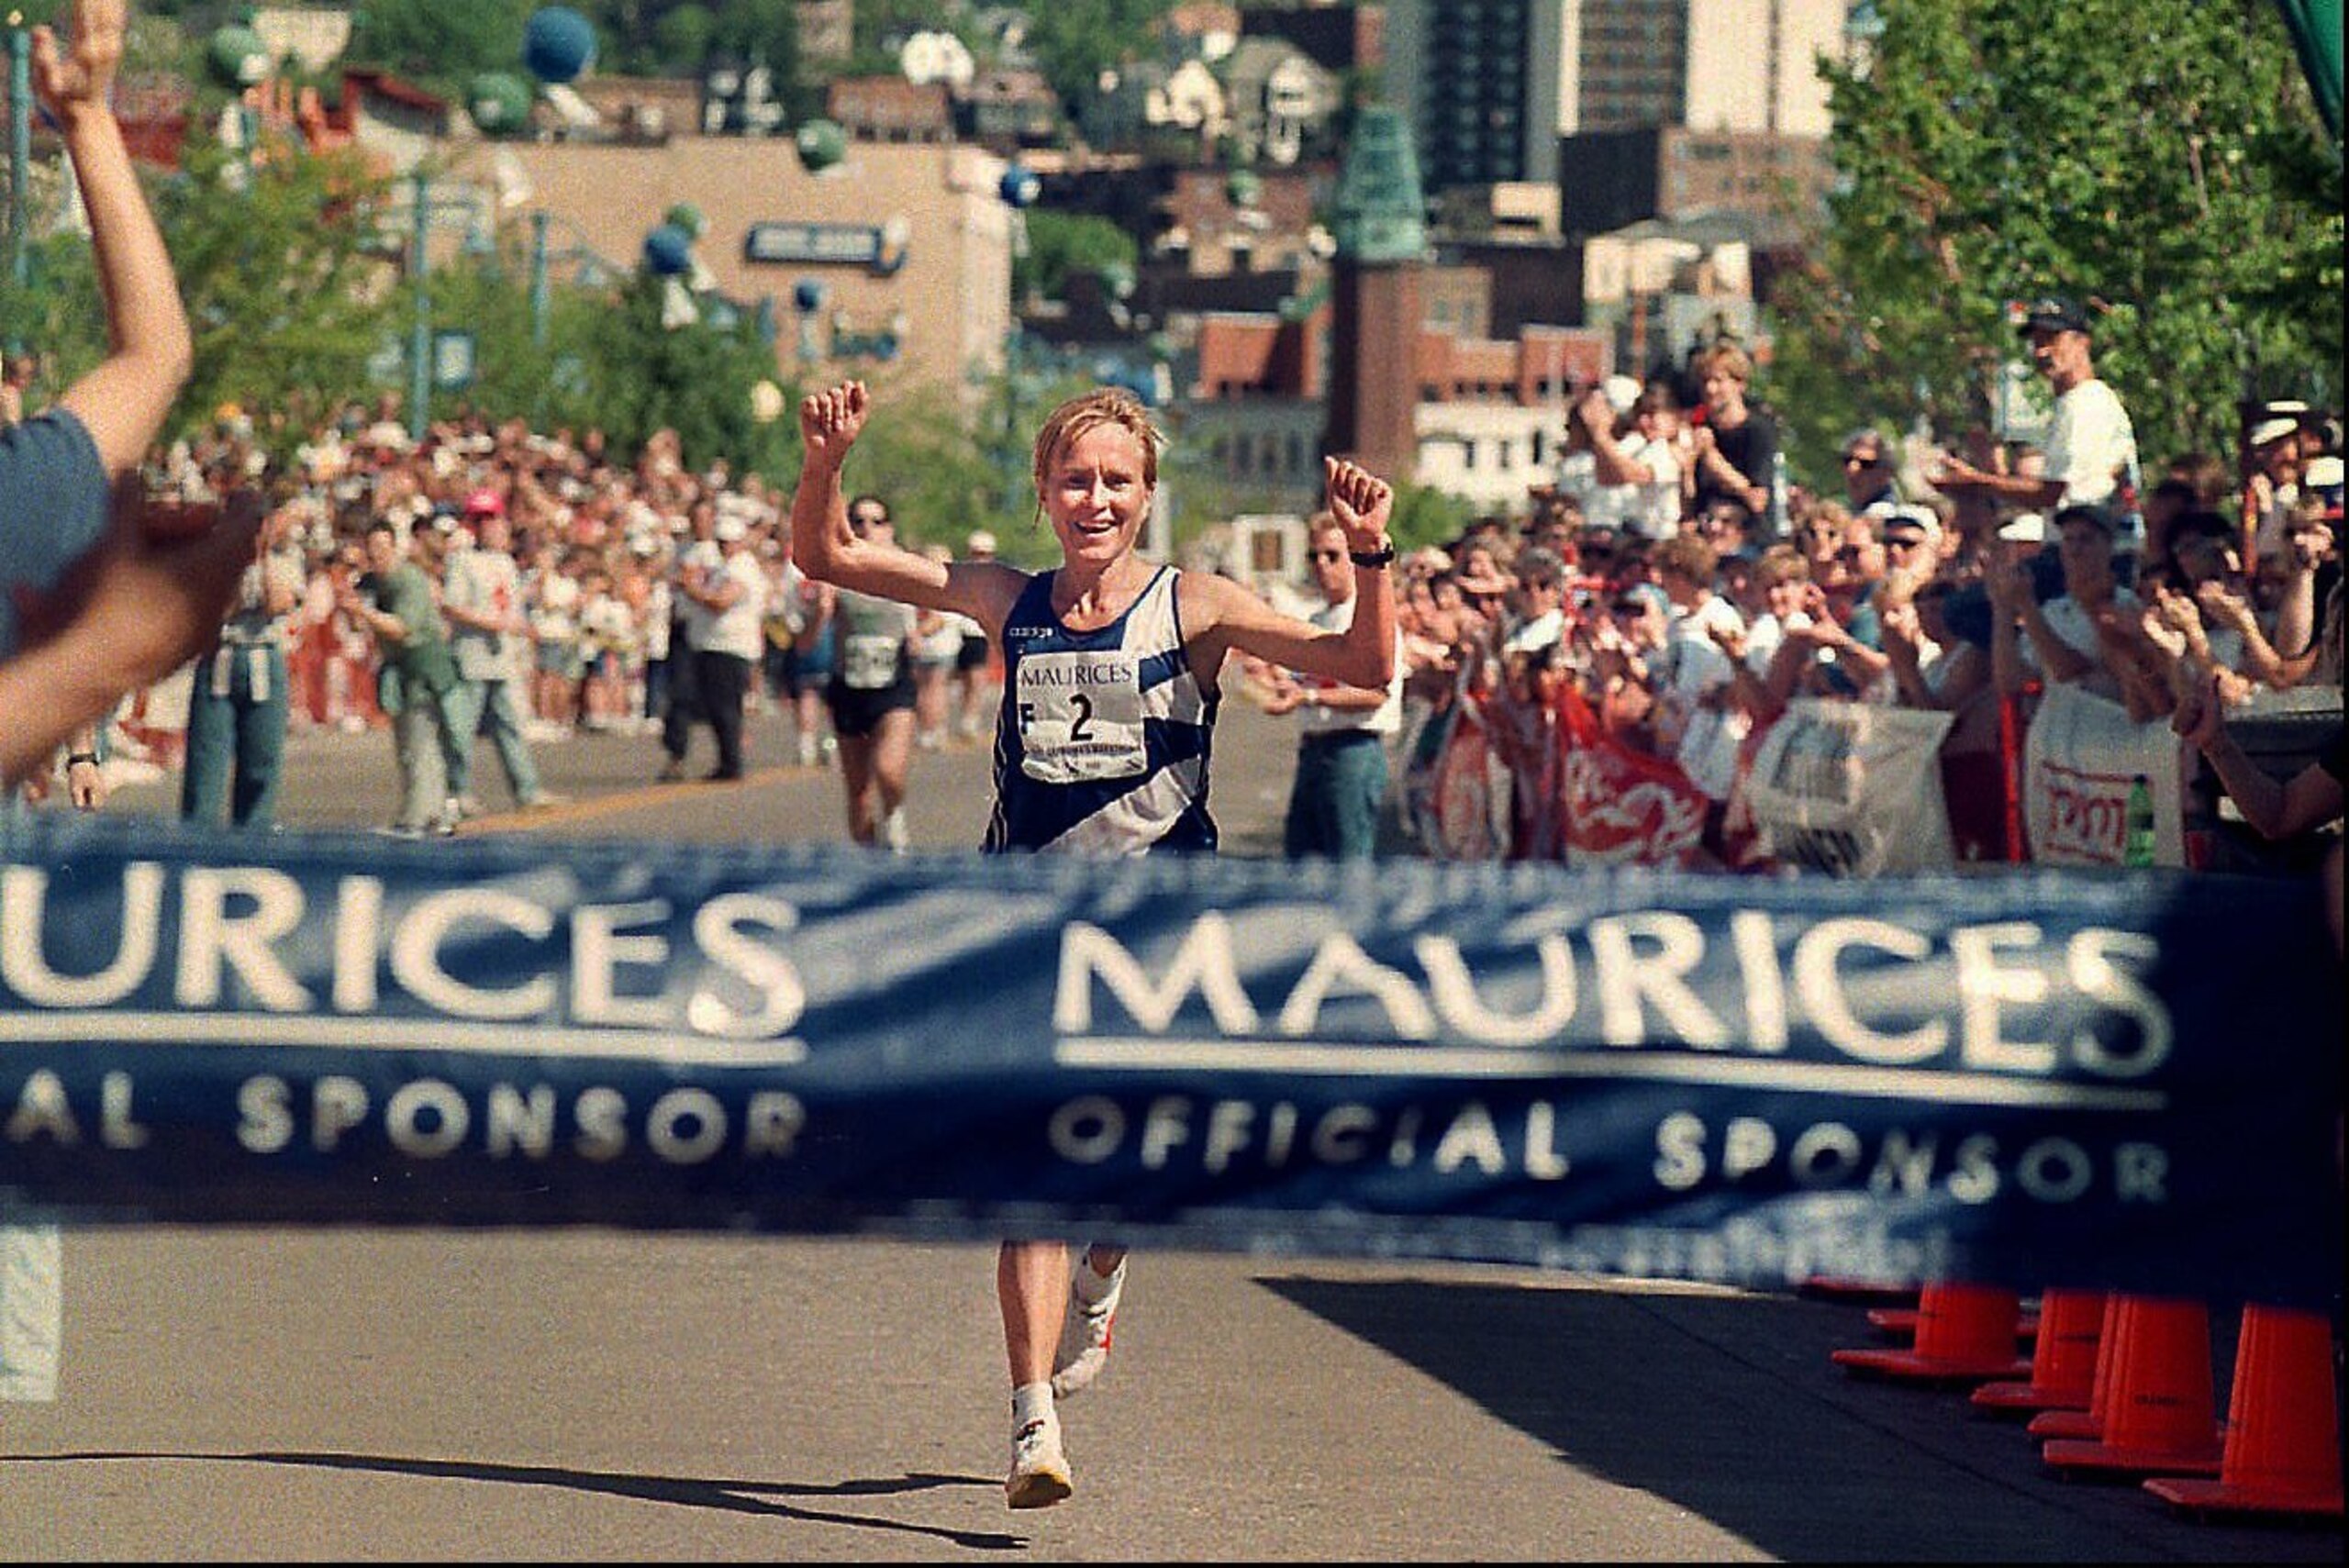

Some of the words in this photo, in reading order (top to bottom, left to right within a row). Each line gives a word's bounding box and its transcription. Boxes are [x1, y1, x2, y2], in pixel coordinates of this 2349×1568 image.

[1019, 703, 1035, 735] F
[1069, 693, 1094, 741] 2
[1021, 664, 1132, 686] MAURICES
[0, 861, 808, 1040] URICES
[1052, 908, 2175, 1078] MAURICES
[6, 1067, 150, 1150] AL
[235, 1073, 809, 1165] SPONSOR
[1047, 1095, 1572, 1182] OFFICIAL
[1653, 1110, 2171, 1205] SPONSOR
